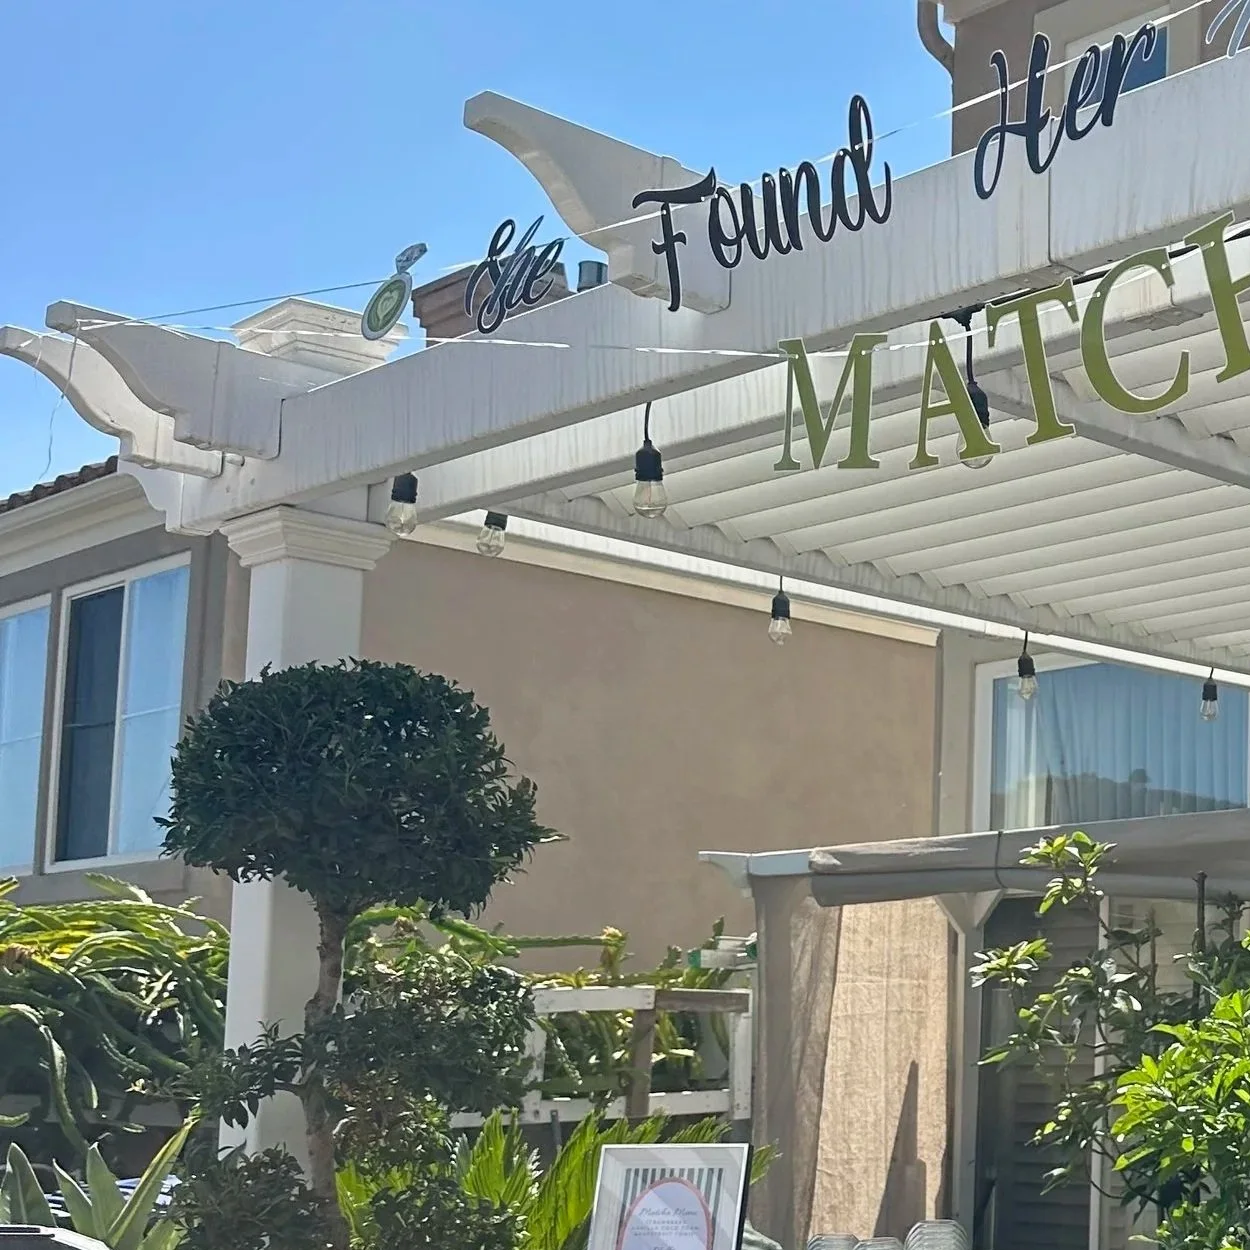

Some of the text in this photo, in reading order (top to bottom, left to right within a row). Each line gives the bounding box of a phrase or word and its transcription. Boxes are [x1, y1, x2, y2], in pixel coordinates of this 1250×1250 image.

[464, 21, 1157, 334] She Found Her
